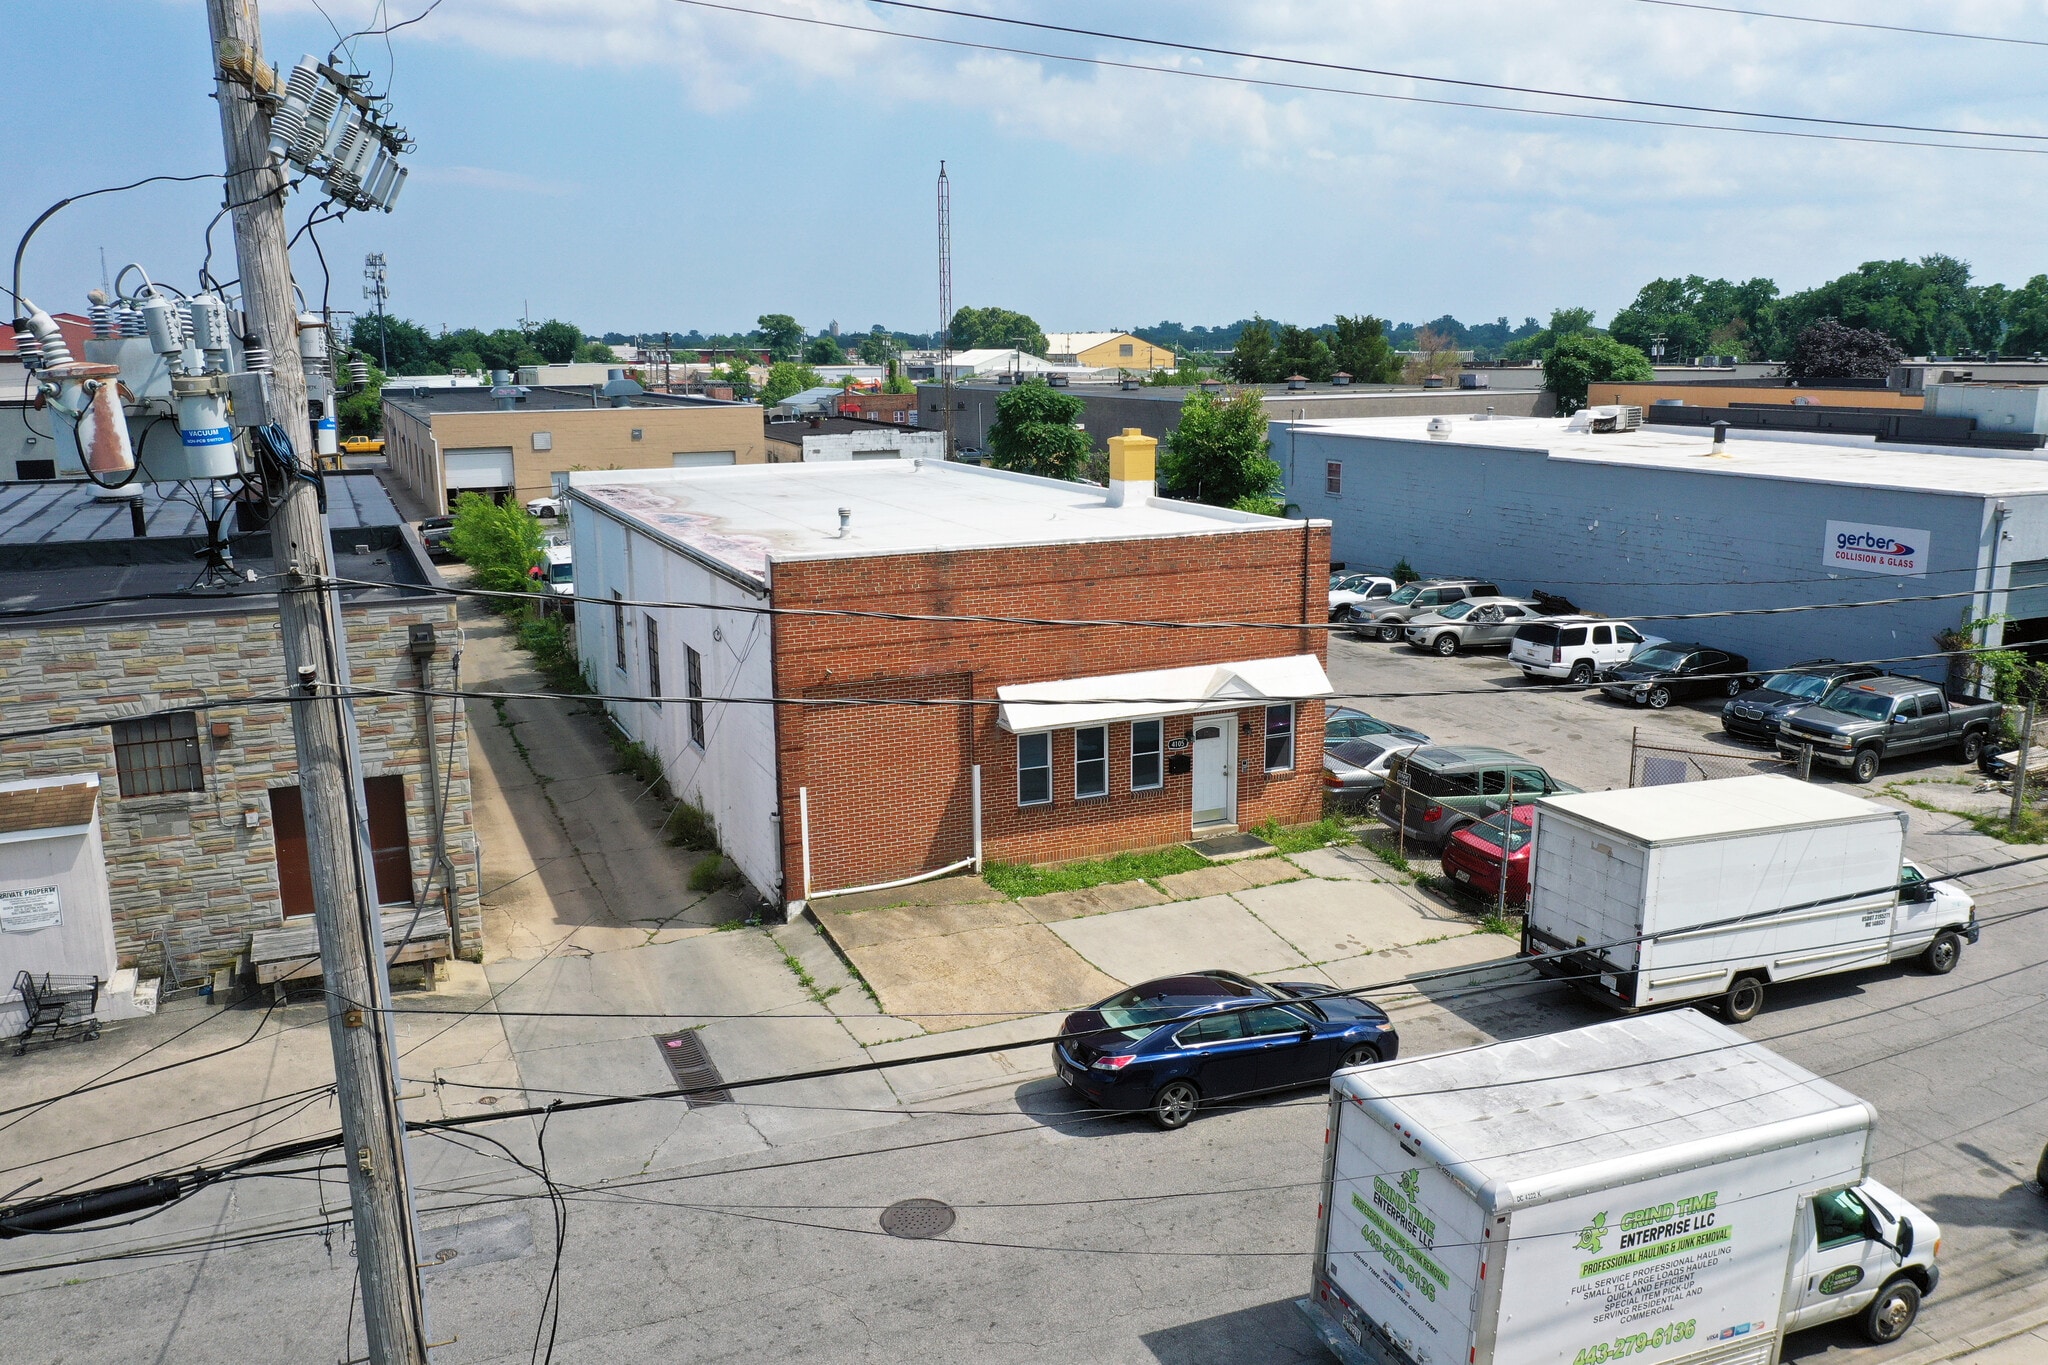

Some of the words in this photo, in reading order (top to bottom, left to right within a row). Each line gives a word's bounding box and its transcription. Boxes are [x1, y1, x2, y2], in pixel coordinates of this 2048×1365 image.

[189, 429, 219, 437] VACUUM
[1835, 551, 1876, 564] COLLISION
[1879, 557, 1885, 565] &
[1887, 558, 1914, 569] GLASS
[1837, 532, 1895, 550] gerber
[1172, 740, 1185, 748] 4105
[1373, 1191, 1418, 1237] ENTERPRISE
[1419, 1229, 1434, 1251] LLC
[1374, 1175, 1407, 1214] GRIND
[1408, 1203, 1436, 1239] TIME
[1620, 1202, 1674, 1231] GRIND
[1677, 1191, 1718, 1218] TIME
[1620, 1218, 1691, 1249] ENTERPRISE
[1694, 1213, 1715, 1230] LLC
[1361, 1223, 1436, 1303] 443-279-6136
[1571, 1283, 1592, 1295] FULL
[1594, 1274, 1630, 1289] SERVICE
[1632, 1257, 1694, 1278] PROFESSIONAL
[1696, 1246, 1732, 1262] HAULING
[1582, 1252, 1637, 1276] PROFESSIONAL
[1638, 1243, 1670, 1262] HAULING
[1671, 1242, 1676, 1251] &
[1677, 1237, 1695, 1251] JUNK
[1696, 1228, 1728, 1246] REMOVAL
[1353, 1252, 1368, 1268] GRIND
[1368, 1266, 1381, 1279] TIME
[1380, 1278, 1396, 1294] GRIND
[1395, 1293, 1409, 1307] TIME
[1408, 1305, 1425, 1322] GRIND
[1425, 1321, 1439, 1335] TIME
[1583, 1287, 1612, 1300] SMALL
[1614, 1283, 1625, 1293] TO
[1626, 1276, 1655, 1289] LARGE
[1656, 1268, 1684, 1282] LOADS
[1686, 1257, 1719, 1274] HAULED
[1604, 1297, 1639, 1312] SPECIAL
[1641, 1291, 1661, 1302] ITEM
[1662, 1280, 1695, 1296] PICK-UP
[1606, 1289, 1633, 1303] QUICK
[1634, 1284, 1653, 1296] AND
[1654, 1272, 1695, 1290] EFFICIENT
[1593, 1308, 1630, 1324] SERVING
[1631, 1295, 1684, 1313] RESIDENTIAL
[1686, 1287, 1703, 1298] AND
[1620, 1304, 1675, 1325] COMMERCIAL
[1573, 1318, 1697, 1365] 443-279-6136
